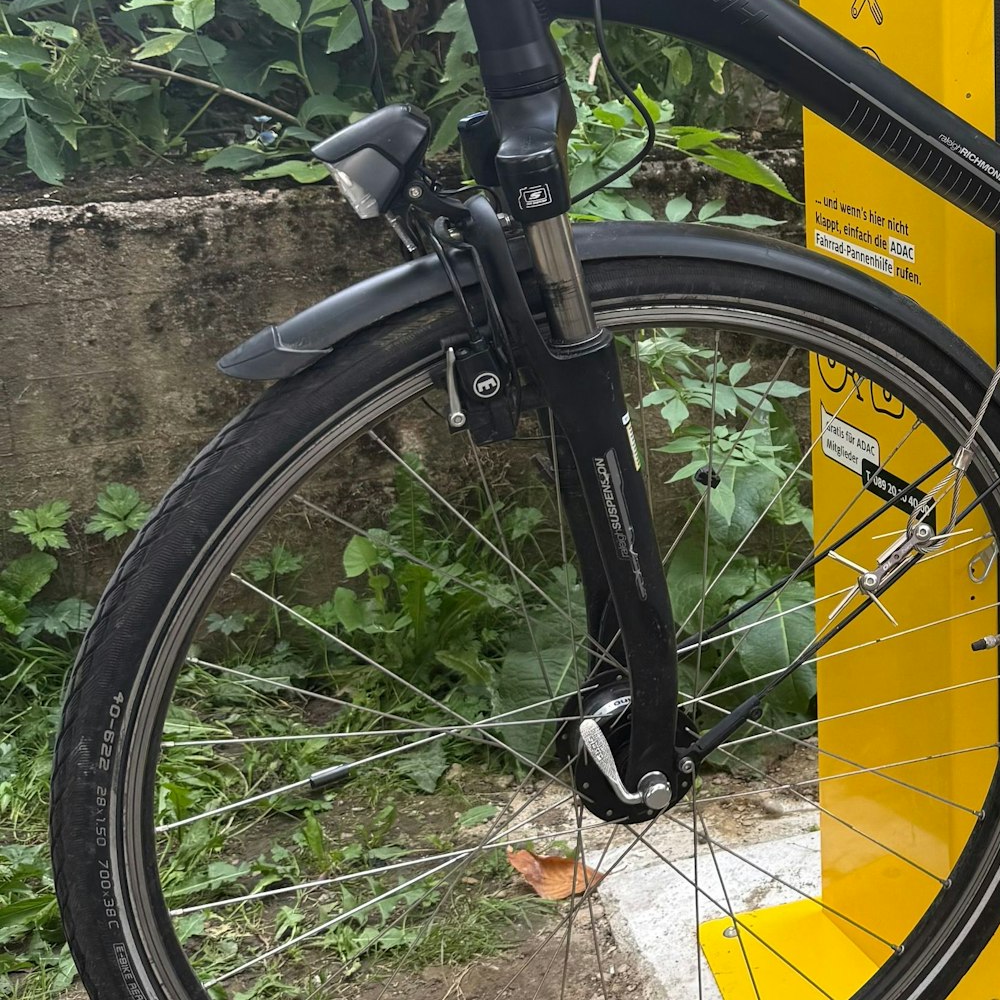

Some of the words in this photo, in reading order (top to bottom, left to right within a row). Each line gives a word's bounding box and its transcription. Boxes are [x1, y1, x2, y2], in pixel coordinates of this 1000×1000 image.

[815, 211, 842, 234] klappt,
[843, 223, 873, 244] einfach
[874, 234, 888, 250] die
[890, 241, 914, 261] ADAC
[823, 196, 838, 210] und
[839, 202, 868, 221] wenn's
[869, 210, 886, 227] hier
[887, 217, 909, 236] nicht
[815, 232, 893, 275] Fahrrad-Pannenhilfe
[896, 266, 922, 285] rufen.
[827, 438, 859, 465] Mitglieder
[845, 431, 856, 446] für
[857, 438, 875, 457] ADAC
[98, 690, 125, 772] 40-622
[116, 945, 134, 982] E-BIKE
